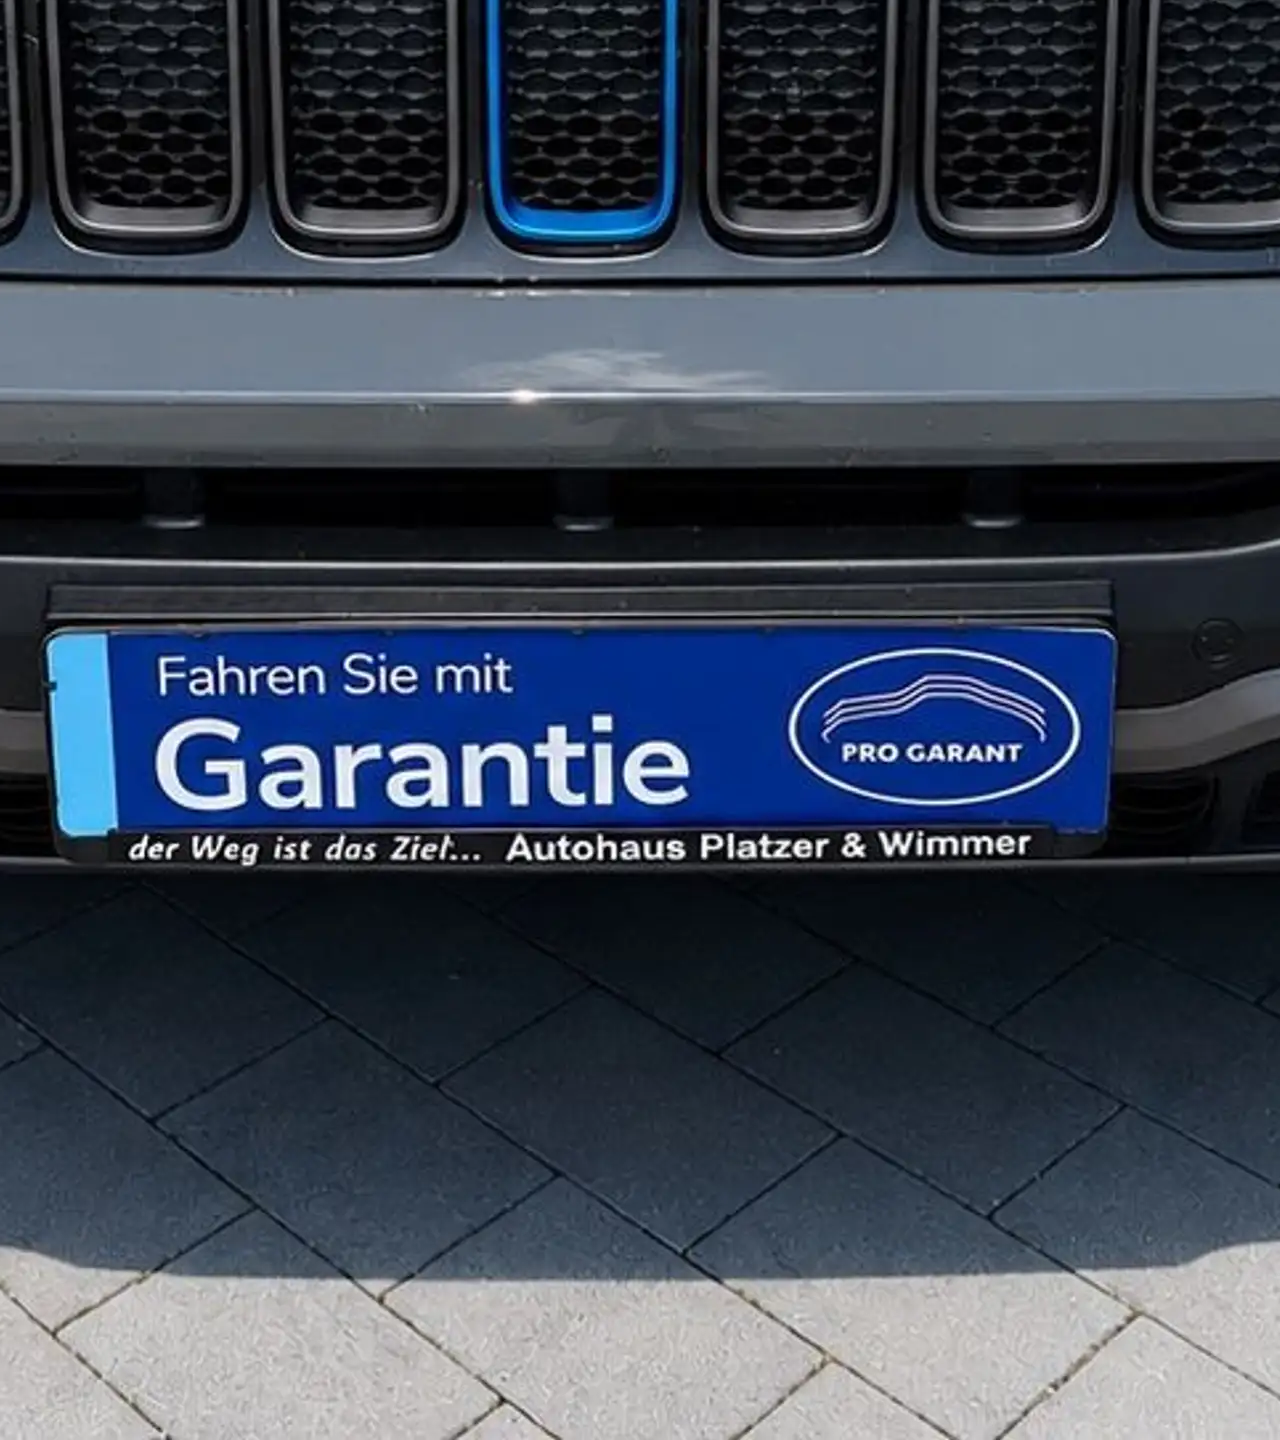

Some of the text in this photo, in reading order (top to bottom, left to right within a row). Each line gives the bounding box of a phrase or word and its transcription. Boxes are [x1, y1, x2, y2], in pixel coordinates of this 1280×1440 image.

[158, 653, 514, 697] Fahren Sie mit
[154, 714, 691, 811] Garantie
[841, 742, 1024, 763] PRO GARANT
[128, 835, 180, 861] der
[190, 835, 260, 866] Weg
[273, 837, 312, 861] ist
[324, 834, 377, 861] das
[506, 830, 1032, 862] Autohaus Platzer & Wimmer
